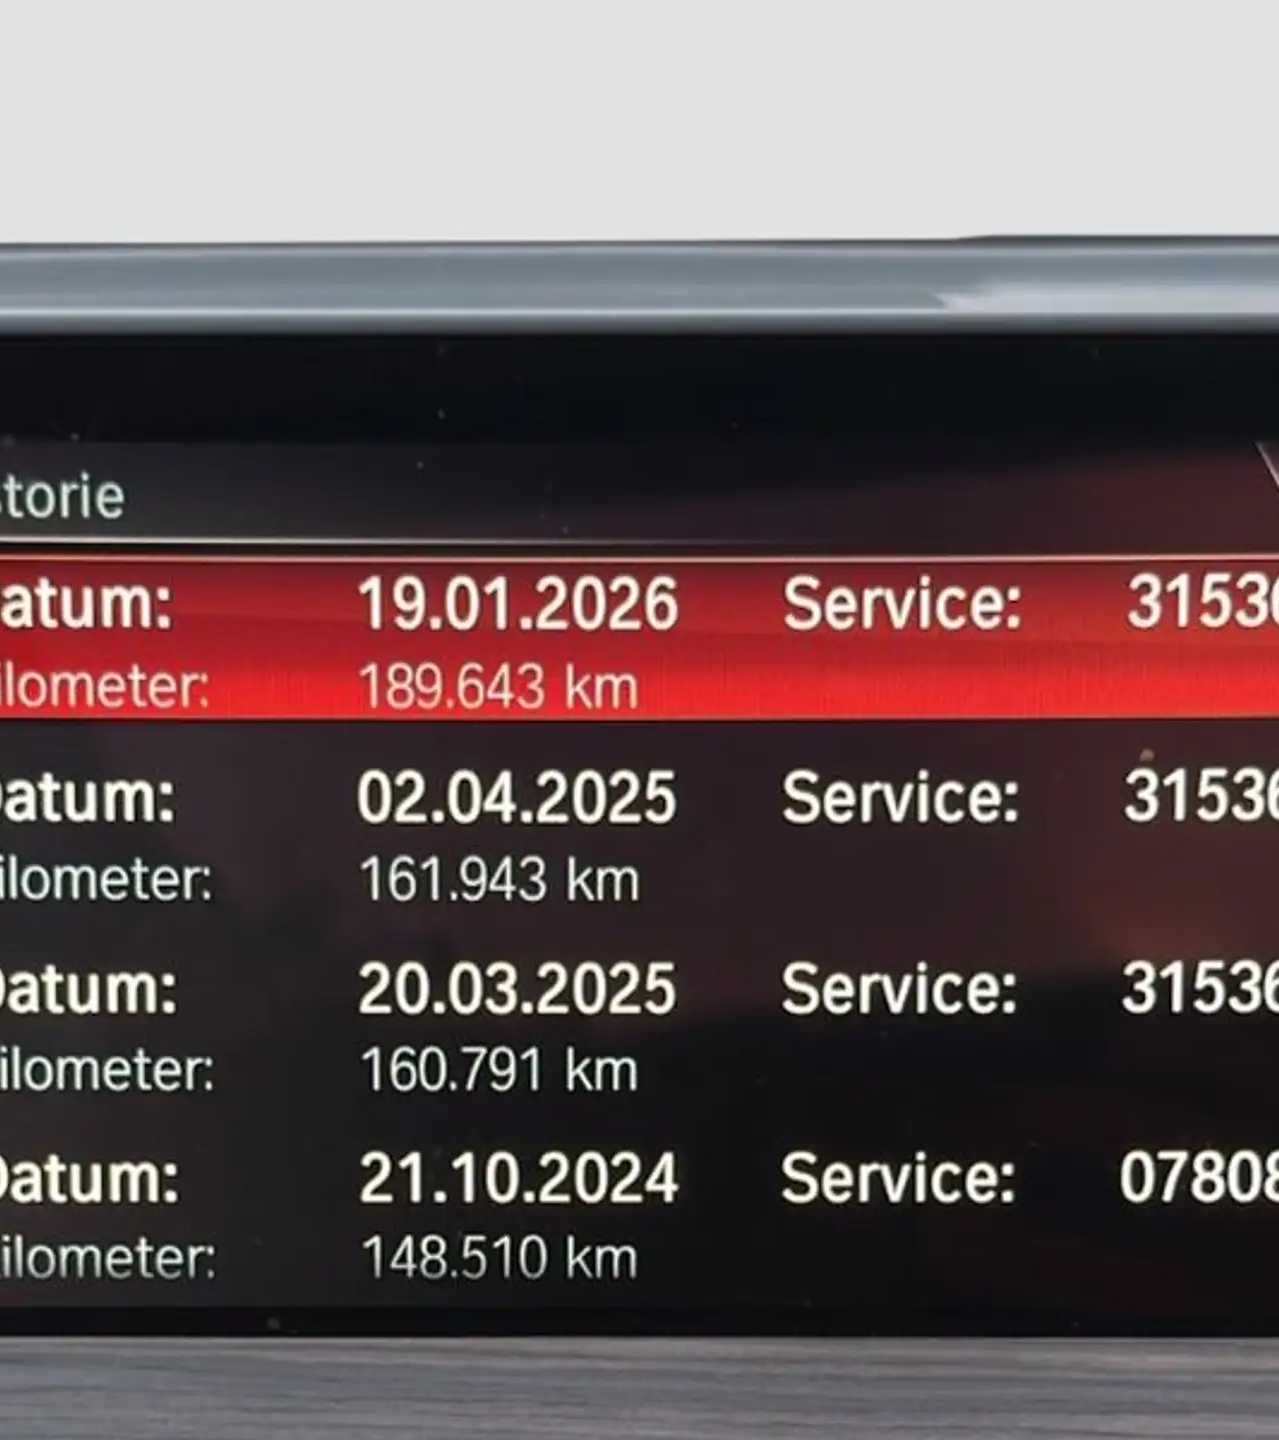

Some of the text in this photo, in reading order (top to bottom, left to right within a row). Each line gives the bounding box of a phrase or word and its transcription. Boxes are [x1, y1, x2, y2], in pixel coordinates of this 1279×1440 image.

[357, 573, 680, 632] 19.01.2026
[783, 573, 1022, 632] Service:
[358, 660, 547, 712] 189.643
[564, 661, 640, 711] km
[356, 767, 678, 826] 02.04.2025
[781, 767, 1020, 826] Service:
[359, 853, 549, 904] 161.943
[566, 854, 640, 903] km
[357, 959, 678, 1017] 20.03.2025
[780, 959, 1018, 1017] Service:
[360, 1043, 540, 1094] 160.791
[565, 1044, 639, 1093] km
[358, 1149, 681, 1206] 21.10.2024
[780, 1149, 1016, 1206] Service:
[361, 1232, 549, 1280] 148.510
[565, 1233, 639, 1280] km
